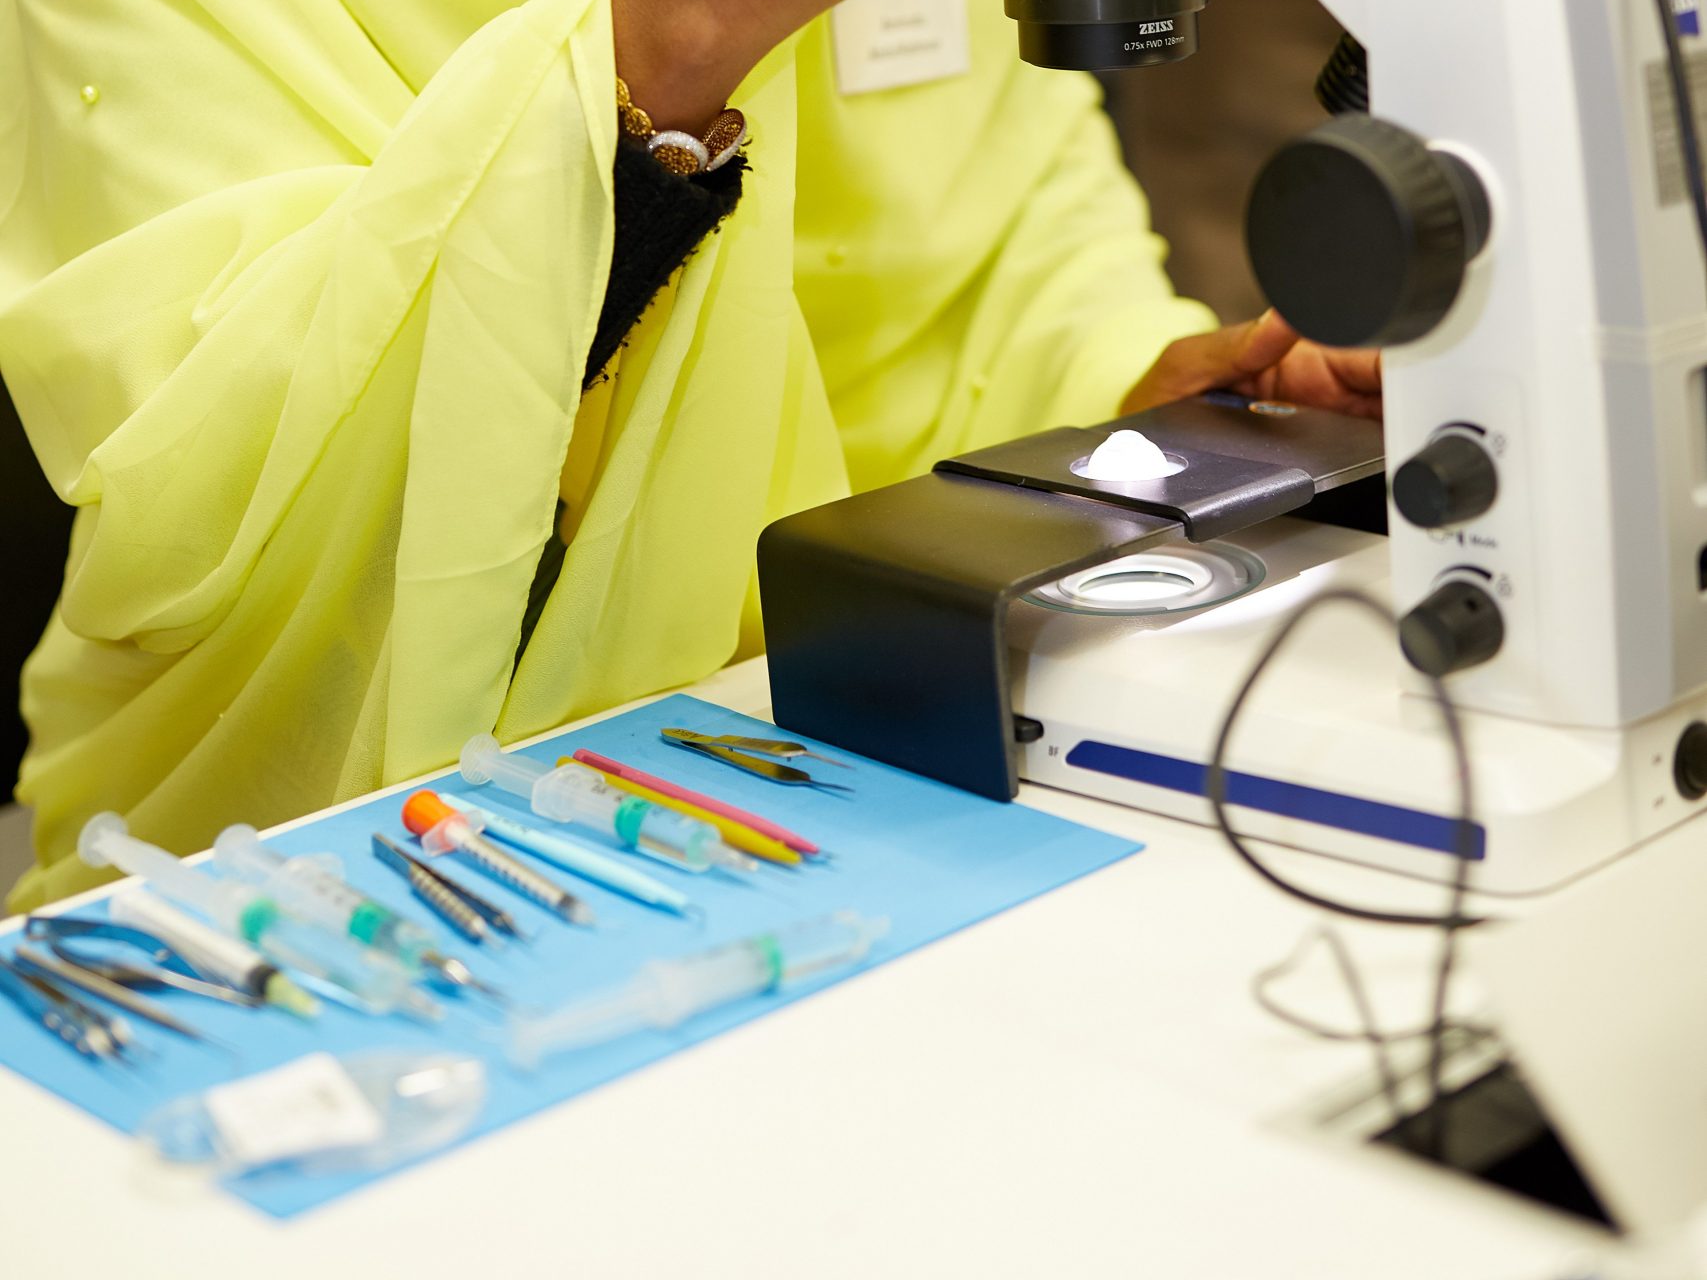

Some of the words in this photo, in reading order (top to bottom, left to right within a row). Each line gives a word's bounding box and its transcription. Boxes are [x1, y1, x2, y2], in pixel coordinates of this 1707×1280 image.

[1139, 20, 1174, 35] ZEISS
[1124, 42, 1145, 51] 0.75x
[1146, 39, 1163, 49] FWD
[1164, 35, 1185, 46] 128mm
